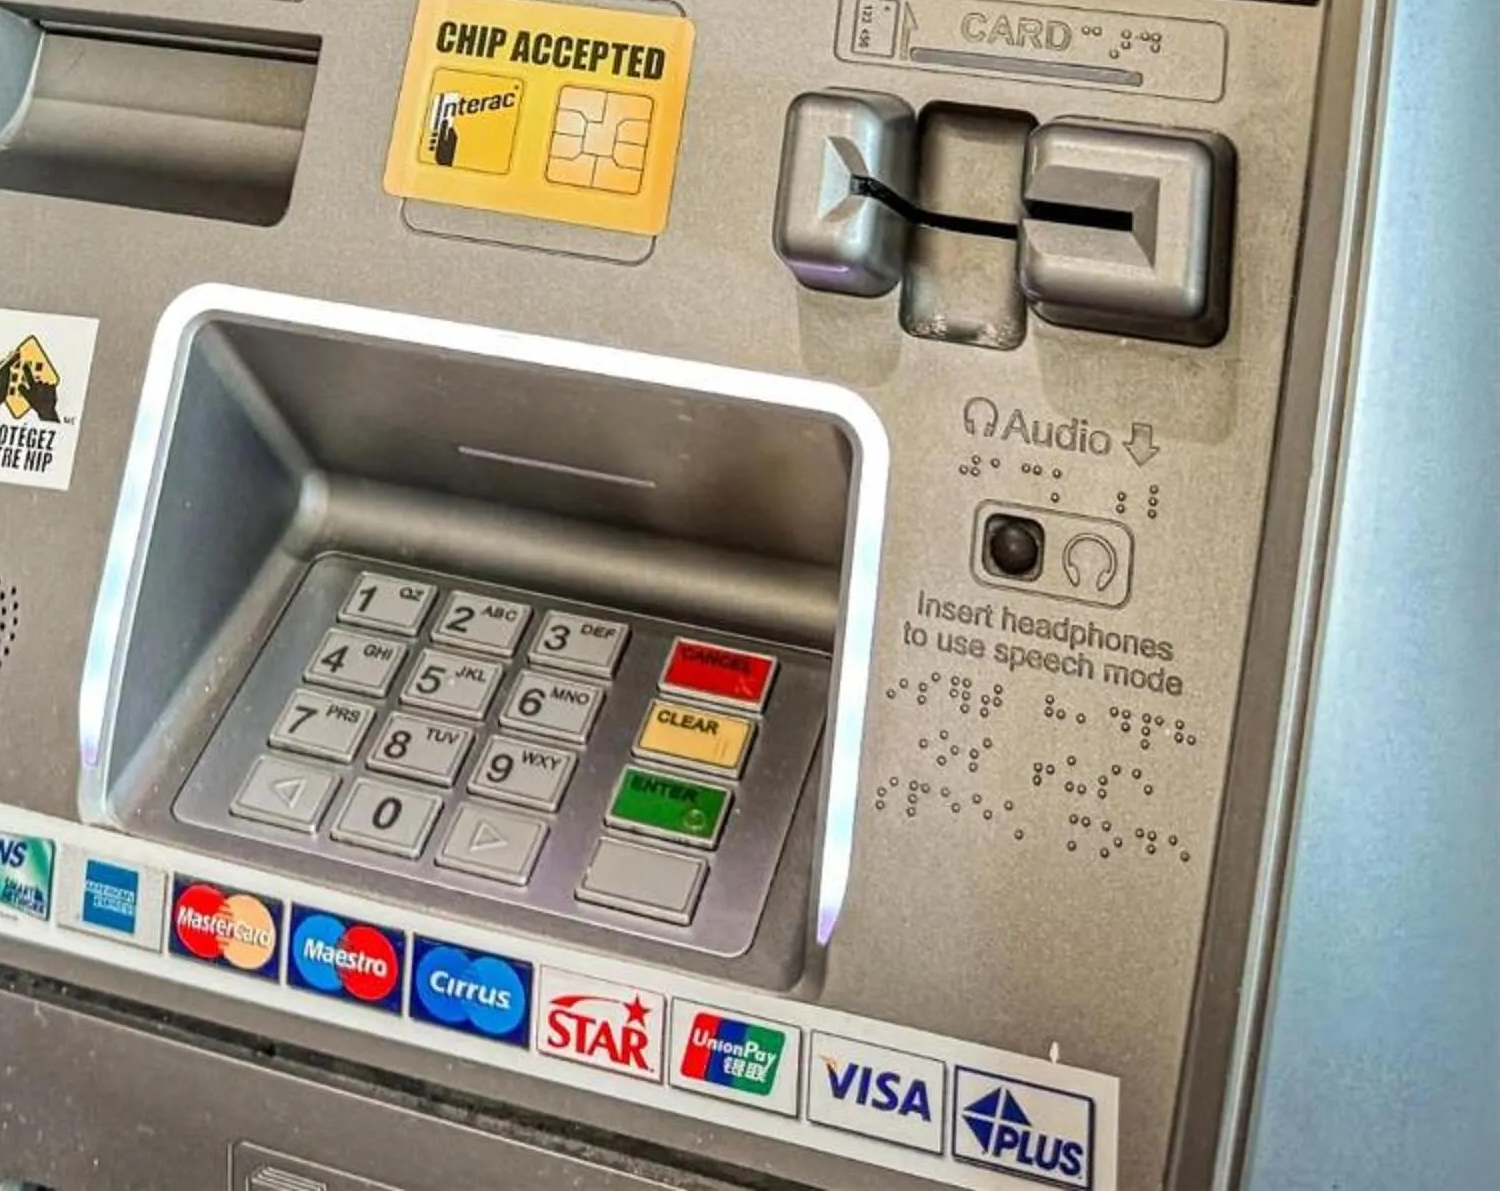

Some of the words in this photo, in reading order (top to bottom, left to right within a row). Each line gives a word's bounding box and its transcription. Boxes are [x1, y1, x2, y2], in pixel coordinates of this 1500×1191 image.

[960, 12, 1073, 52] CARD
[435, 20, 508, 59] CHIP
[509, 29, 666, 81] ACCEPTED
[434, 92, 517, 131] Interac
[1000, 408, 1113, 457] Audio
[23, 449, 53, 473] NIP
[357, 585, 378, 613] 1
[398, 586, 425, 602] QZ
[445, 606, 475, 634] 2
[481, 605, 518, 622] ABC
[916, 589, 994, 629] Insert
[1000, 605, 1175, 662] headphones
[543, 624, 571, 651] 3
[579, 624, 617, 640] DEF
[320, 645, 349, 674] 4
[363, 644, 394, 661] GHI
[680, 645, 754, 674] CANCEL
[902, 620, 929, 648] to
[936, 631, 986, 659] use
[993, 640, 1096, 681] speech
[1103, 660, 1184, 697] mode
[415, 665, 446, 694] 5
[455, 665, 487, 682] JKL
[518, 688, 546, 717] 6
[550, 687, 591, 706] MNO
[288, 706, 319, 735] 7
[325, 704, 361, 724] PRS
[656, 709, 721, 736] CLEAR
[383, 729, 412, 759] 8
[425, 726, 461, 745] TUV
[485, 753, 515, 783] 9
[521, 750, 562, 771] WXY
[629, 774, 700, 803] ENTER
[371, 796, 403, 830] 0
[177, 904, 272, 947] MasterCard
[302, 936, 389, 978] Maestro
[428, 969, 512, 1010] Cirrus
[546, 1008, 651, 1072] STAR
[692, 1026, 777, 1075] UnionPay
[825, 1060, 932, 1122] VISA
[992, 1127, 1085, 1177] PLUS
